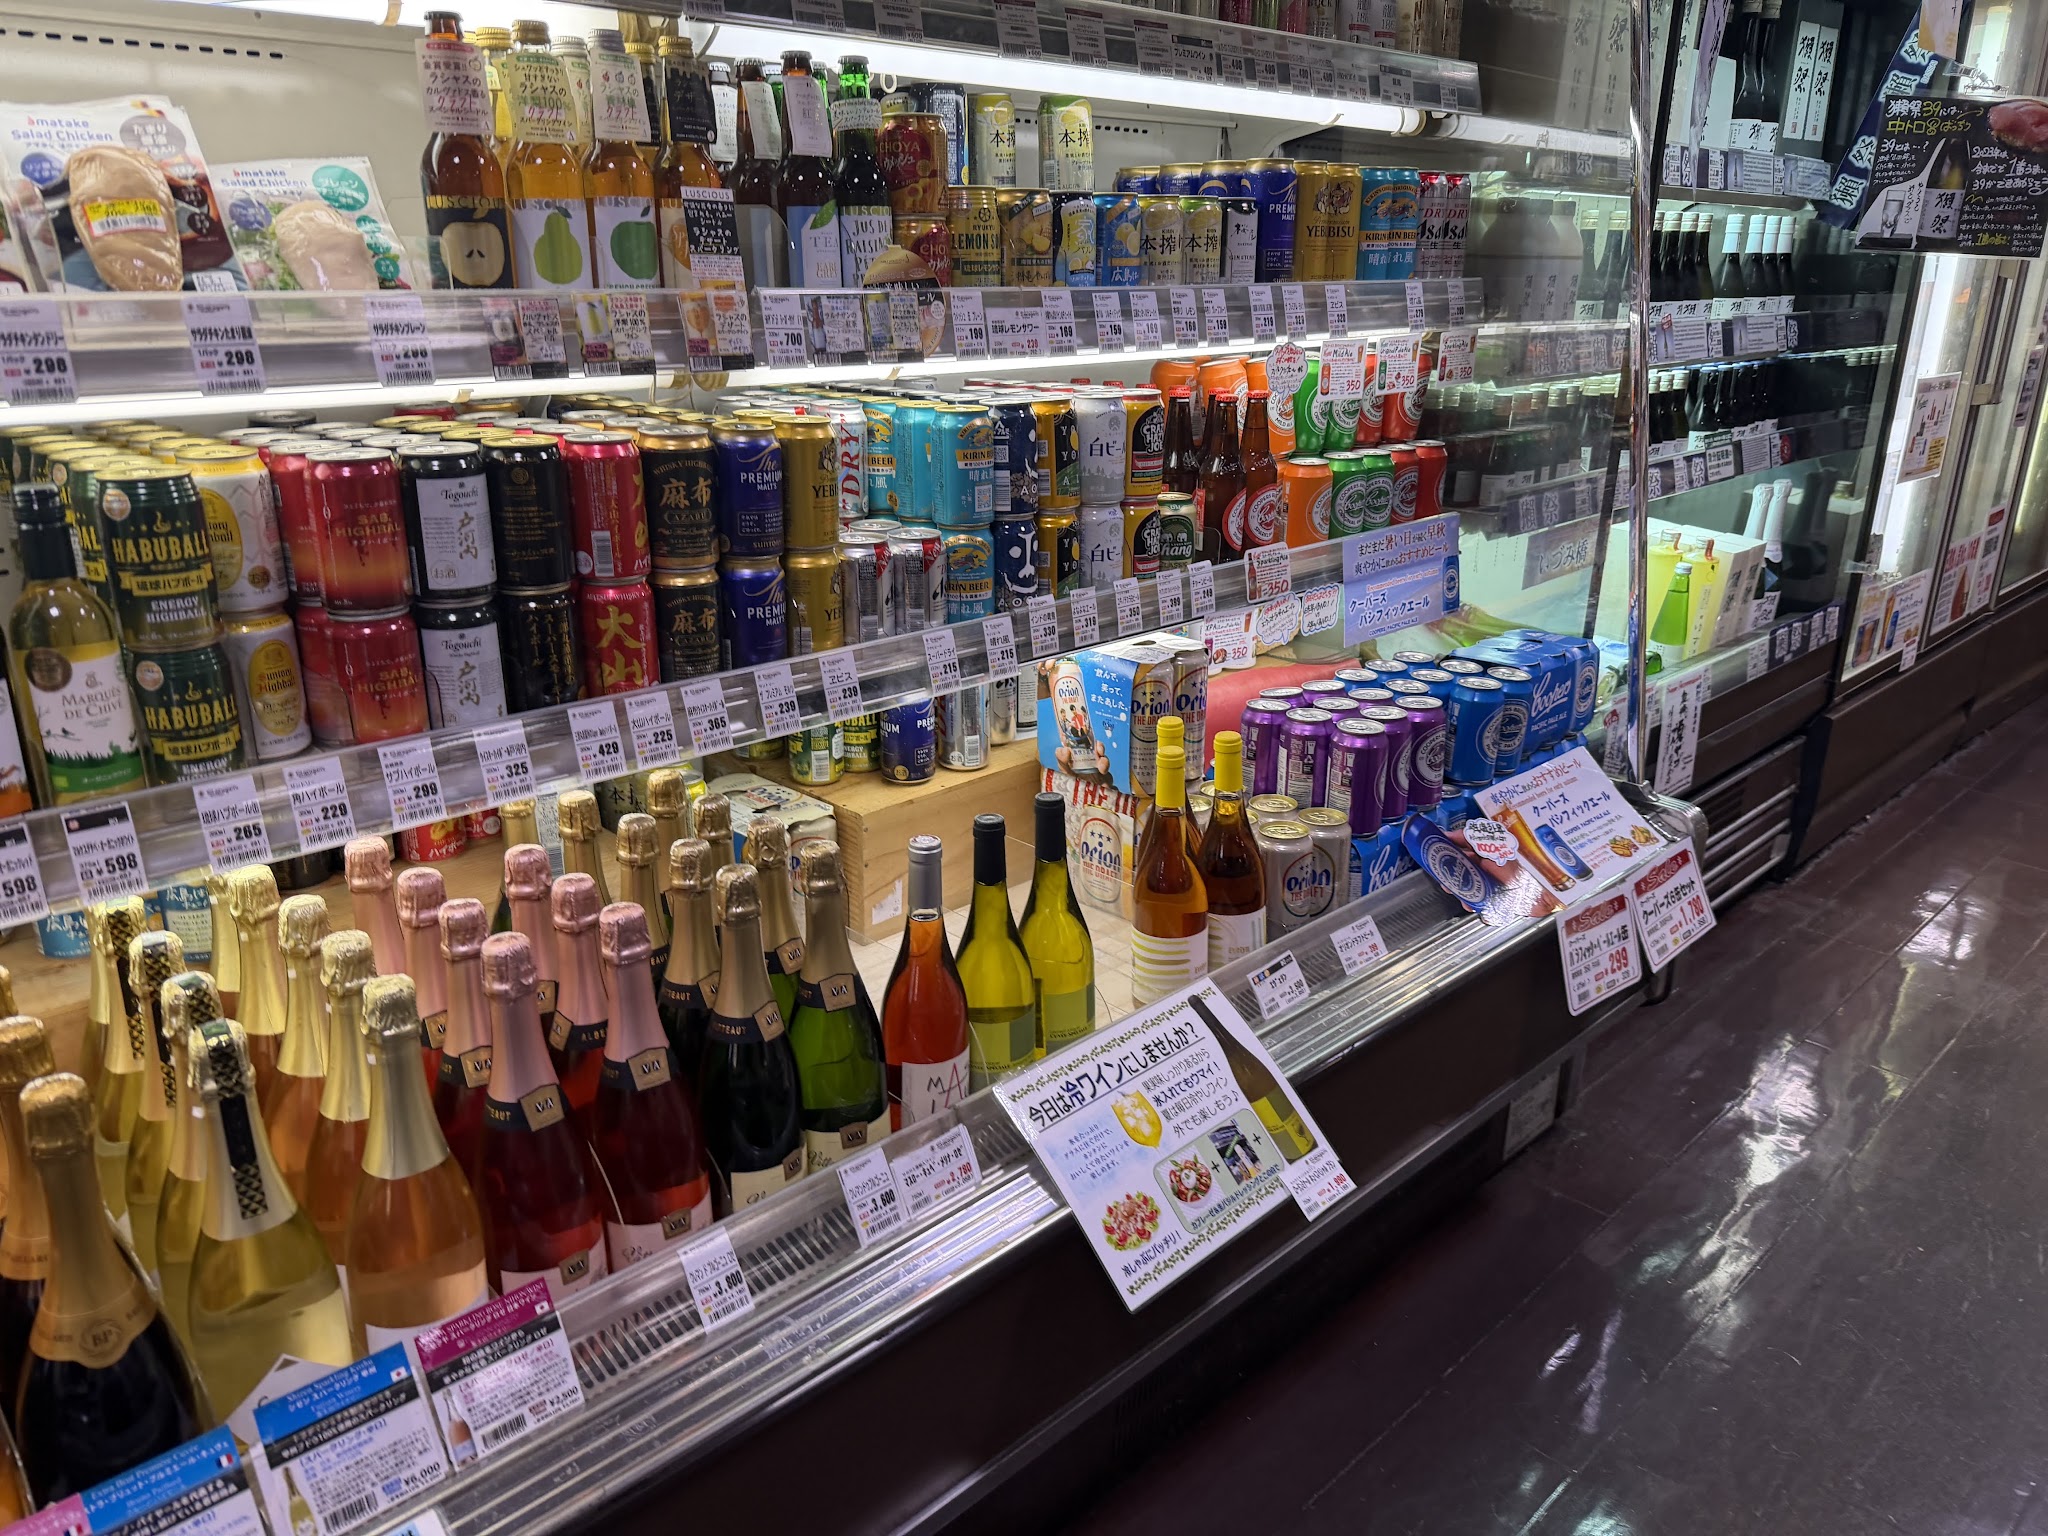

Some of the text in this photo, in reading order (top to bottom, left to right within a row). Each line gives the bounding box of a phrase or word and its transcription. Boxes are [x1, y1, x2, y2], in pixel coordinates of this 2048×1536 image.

[27, 116, 89, 128] amatake
[11, 130, 113, 142] Salad Chicken
[880, 141, 920, 152] CHOYA
[685, 189, 730, 200] LUSCIOUS
[784, 333, 802, 346] 700
[992, 325, 1040, 336] 琉球レモンサワー
[1401, 374, 1415, 387] 350
[1458, 366, 1473, 378] 350
[1345, 379, 1361, 392] 350
[871, 456, 893, 465] BEER
[962, 450, 986, 460] KIRIN
[441, 487, 479, 501] Togouchi
[660, 476, 713, 509] 麻布
[357, 512, 391, 525] SAB.
[112, 533, 210, 562] HABUBALL
[1357, 522, 1446, 556] まだまだ暑い日が続く早秋
[1355, 542, 1450, 576] 爽やかに飲めるおすすめビール
[136, 576, 204, 591] 琉球ハブボール
[968, 580, 989, 591] BEER
[1267, 579, 1290, 598] 350
[150, 597, 199, 611] ENERGY
[1349, 590, 1388, 613] クーパーズ
[672, 609, 716, 633] 麻布
[1358, 595, 1431, 628] パシフィックエール
[1042, 625, 1056, 638] 330
[441, 637, 482, 650] Togouchi
[1231, 646, 1248, 660] 350
[928, 647, 956, 664] スーパードライ
[1001, 648, 1014, 661] 215
[943, 662, 958, 675] 215
[1094, 668, 1119, 684] 飲んで、
[1058, 686, 1080, 698] Orion
[1101, 684, 1124, 697] 笑って、
[1531, 672, 1572, 722] Coopers
[145, 694, 238, 731] HABUBALL
[1090, 695, 1130, 712] またあした。
[1131, 697, 1171, 716] Orion
[65, 708, 82, 720] DE
[1531, 712, 1567, 732] PACIFIC PALE ALE
[653, 730, 673, 743] 225
[181, 757, 228, 775] ENERGY
[506, 762, 529, 778] 325
[1532, 792, 1570, 818] クーパーズ
[1549, 791, 1611, 828] パシフィックエール
[1563, 809, 1611, 836] COOPERS PACIFIC PALE ALE
[105, 853, 138, 874] 598
[1081, 841, 1121, 872] Orion
[1646, 859, 1680, 890] Sale
[3, 876, 38, 898] 598
[1338, 930, 1374, 953] オリオンドラフトビール
[1028, 1021, 1200, 1127] 今日は冷ワインにしませんか?
[1141, 1048, 1211, 1093] 果実味しっかりあるから
[1152, 1061, 1221, 1108] 氷入れてもウマイ!
[1160, 1075, 1229, 1124] 夏は毎日冷やしワイン
[1068, 1123, 1099, 1145] 氷をたっぷり
[1070, 1139, 1130, 1181] おいしくて冷たいワインを
[1082, 1141, 1108, 1160] カンタンに
[1090, 1160, 1120, 1180] 楽しめます。
[1122, 1231, 1182, 1279] 冷しゃぶにバッチリ!
[714, 1270, 743, 1296] 3,800
[403, 1463, 441, 1489] ¥6,000
